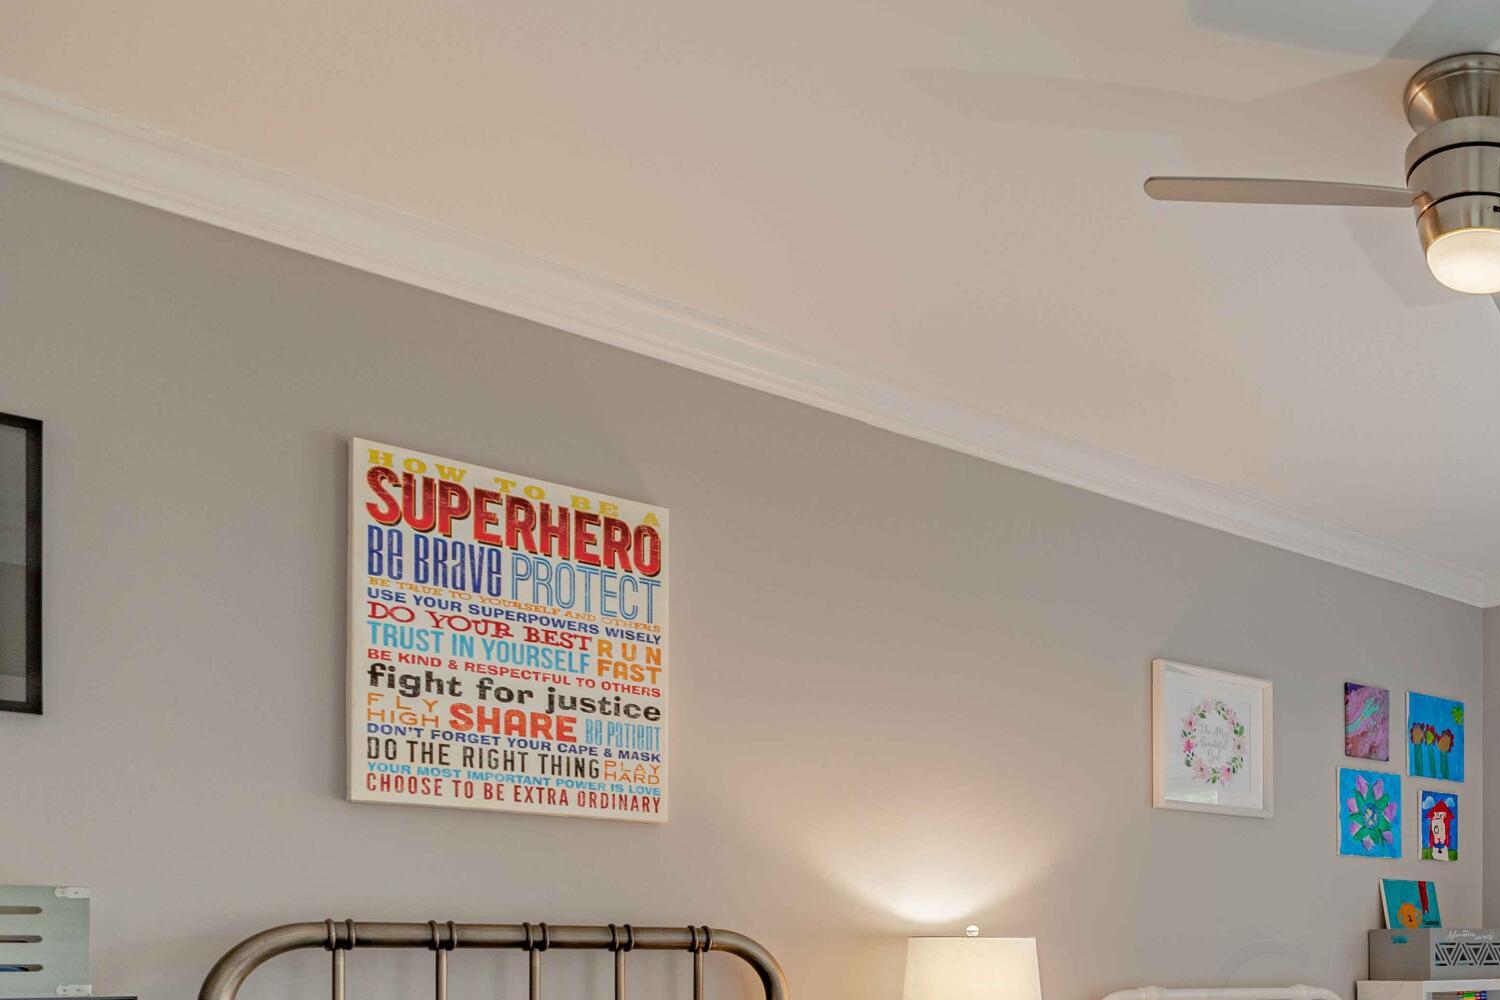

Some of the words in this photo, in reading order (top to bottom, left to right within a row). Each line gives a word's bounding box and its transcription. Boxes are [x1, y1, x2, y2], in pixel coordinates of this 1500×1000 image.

[367, 449, 467, 482] HOW
[494, 477, 545, 501] TO
[570, 495, 618, 518] BE
[642, 511, 660, 528] A
[365, 466, 662, 578] SUPERHERO
[368, 577, 391, 588] BE
[397, 582, 443, 596] TRUE
[448, 590, 472, 601] TO
[479, 595, 561, 616] YOURSELF
[564, 610, 596, 622] AND
[601, 618, 661, 633] OTHERS
[511, 552, 661, 625] PROTECT
[368, 587, 406, 604] USE
[413, 594, 462, 613] YOUR
[468, 604, 599, 635] SUPERPOWERS
[605, 627, 661, 645] WISELY
[368, 601, 415, 623] DO
[425, 610, 514, 639] YOUR
[523, 626, 592, 651] BEST
[367, 621, 444, 654] TRUST
[452, 633, 474, 659] IN
[482, 638, 591, 674] YOURSELF
[597, 638, 661, 665] RUN
[367, 648, 392, 661] BE
[398, 652, 442, 668] KIND
[448, 660, 458, 671] &
[464, 662, 571, 686] RESPECTFUL
[576, 677, 596, 689] TO
[601, 681, 661, 698] OTHERS
[597, 658, 661, 684] FAST
[367, 663, 463, 698] fight
[476, 677, 534, 704] for
[545, 687, 661, 722] justice
[367, 692, 438, 713] FLY
[367, 708, 439, 728] HIGH
[449, 703, 577, 743] SHARE
[367, 723, 424, 738] DON'T
[431, 729, 501, 746] FORGET
[508, 738, 551, 752] YOUR
[557, 743, 598, 757] CAPE
[603, 748, 612, 758] &
[618, 750, 661, 763] MASK
[367, 736, 397, 760] DO
[406, 740, 450, 766] THE
[462, 745, 528, 772] RIGHT
[537, 754, 599, 779] THING
[367, 762, 412, 775] YOUR
[417, 766, 462, 779] MOST
[467, 771, 550, 786] IMPORTANT
[556, 778, 606, 792] POWER
[611, 783, 624, 793] IS
[628, 785, 661, 797] LOVE
[604, 760, 660, 775] PLAY
[604, 770, 660, 785] HARD
[366, 772, 443, 796] CHOOSE
[451, 780, 474, 799] TO
[484, 782, 505, 801] BE
[513, 785, 569, 806] EXTRA
[577, 791, 661, 814] ORDINARY
